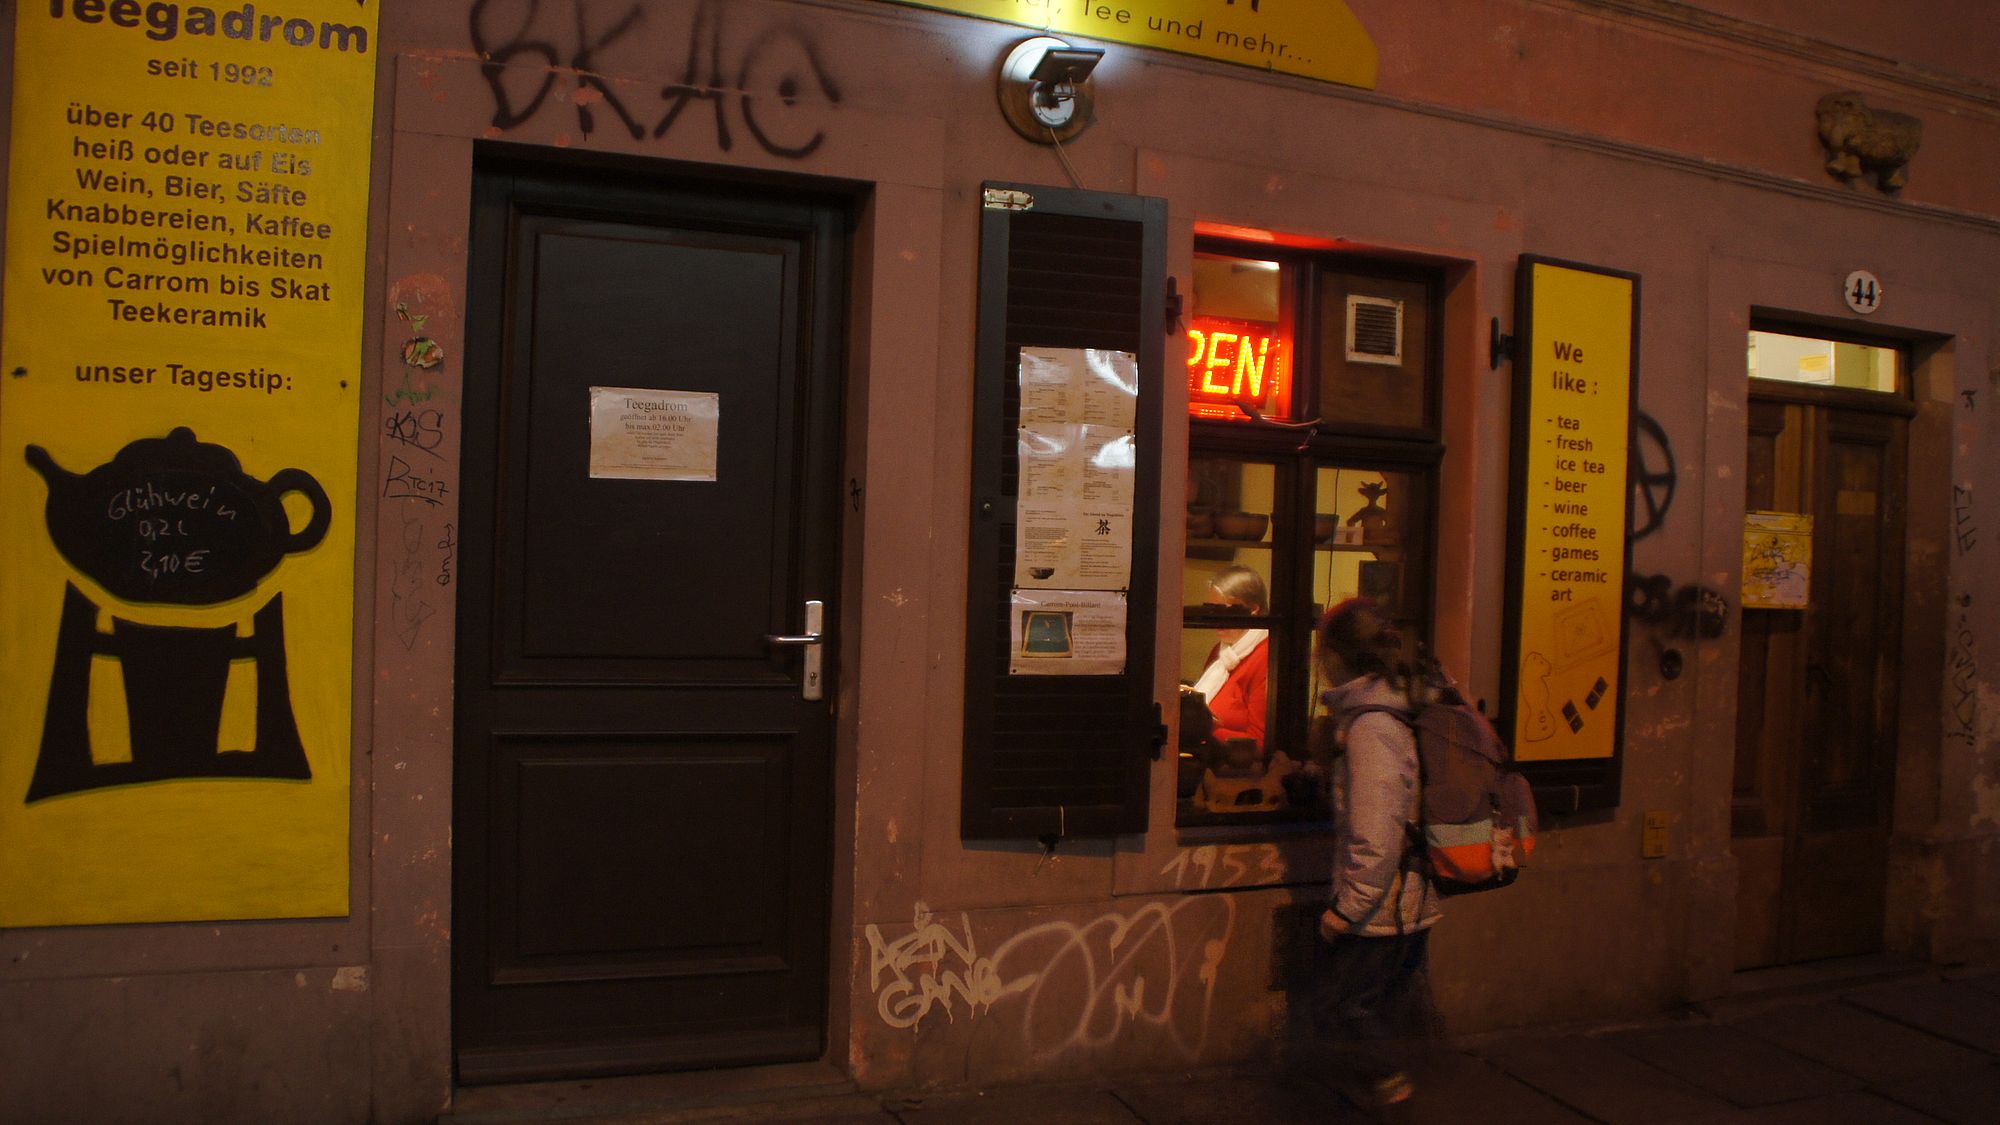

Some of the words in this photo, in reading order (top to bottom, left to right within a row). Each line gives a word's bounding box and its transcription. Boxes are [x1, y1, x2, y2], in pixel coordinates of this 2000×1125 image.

[1148, 16, 1203, 39] und
[1216, 33, 1312, 63] mehr...
[147, 57, 198, 80] seit
[209, 61, 274, 88] 1992
[66, 102, 133, 129] über
[141, 111, 175, 133] 40
[185, 113, 321, 145] Teesorten
[73, 136, 133, 161] heiß
[144, 144, 209, 168] oder
[218, 151, 261, 172] auf
[271, 152, 312, 176] Eis
[76, 168, 154, 198] Wein,
[165, 175, 225, 204] Bier,
[236, 181, 307, 206] Säfte
[46, 198, 235, 236] Knabbereien,
[246, 213, 331, 240] Kaffee
[52, 231, 322, 270] Spielmöglichkeiten
[42, 267, 93, 286] von
[104, 266, 209, 294] Carrom
[220, 275, 260, 297] bis
[270, 277, 330, 301] Skat
[1852, 278, 1877, 306] 44
[107, 299, 266, 328] Teekeramik
[1188, 330, 1270, 396] PEN
[1554, 341, 1584, 363] We
[76, 364, 156, 384] unser
[166, 364, 292, 394] Tagestip:
[1553, 371, 1586, 394] like
[623, 398, 688, 412] Teegadrom
[1557, 415, 1580, 430] tea
[1556, 435, 1593, 452] fresh
[1556, 457, 1576, 471] ice
[1583, 458, 1605, 474] tea
[1554, 476, 1588, 493] beer
[107, 482, 236, 520] Glühwein
[1553, 501, 1588, 516] wine
[139, 519, 171, 541] 0,2
[1552, 523, 1597, 540] coffee
[1551, 547, 1600, 563] games
[1551, 568, 1607, 584] ceramic
[1551, 588, 1572, 602] art
[1160, 843, 1286, 890] 1953
